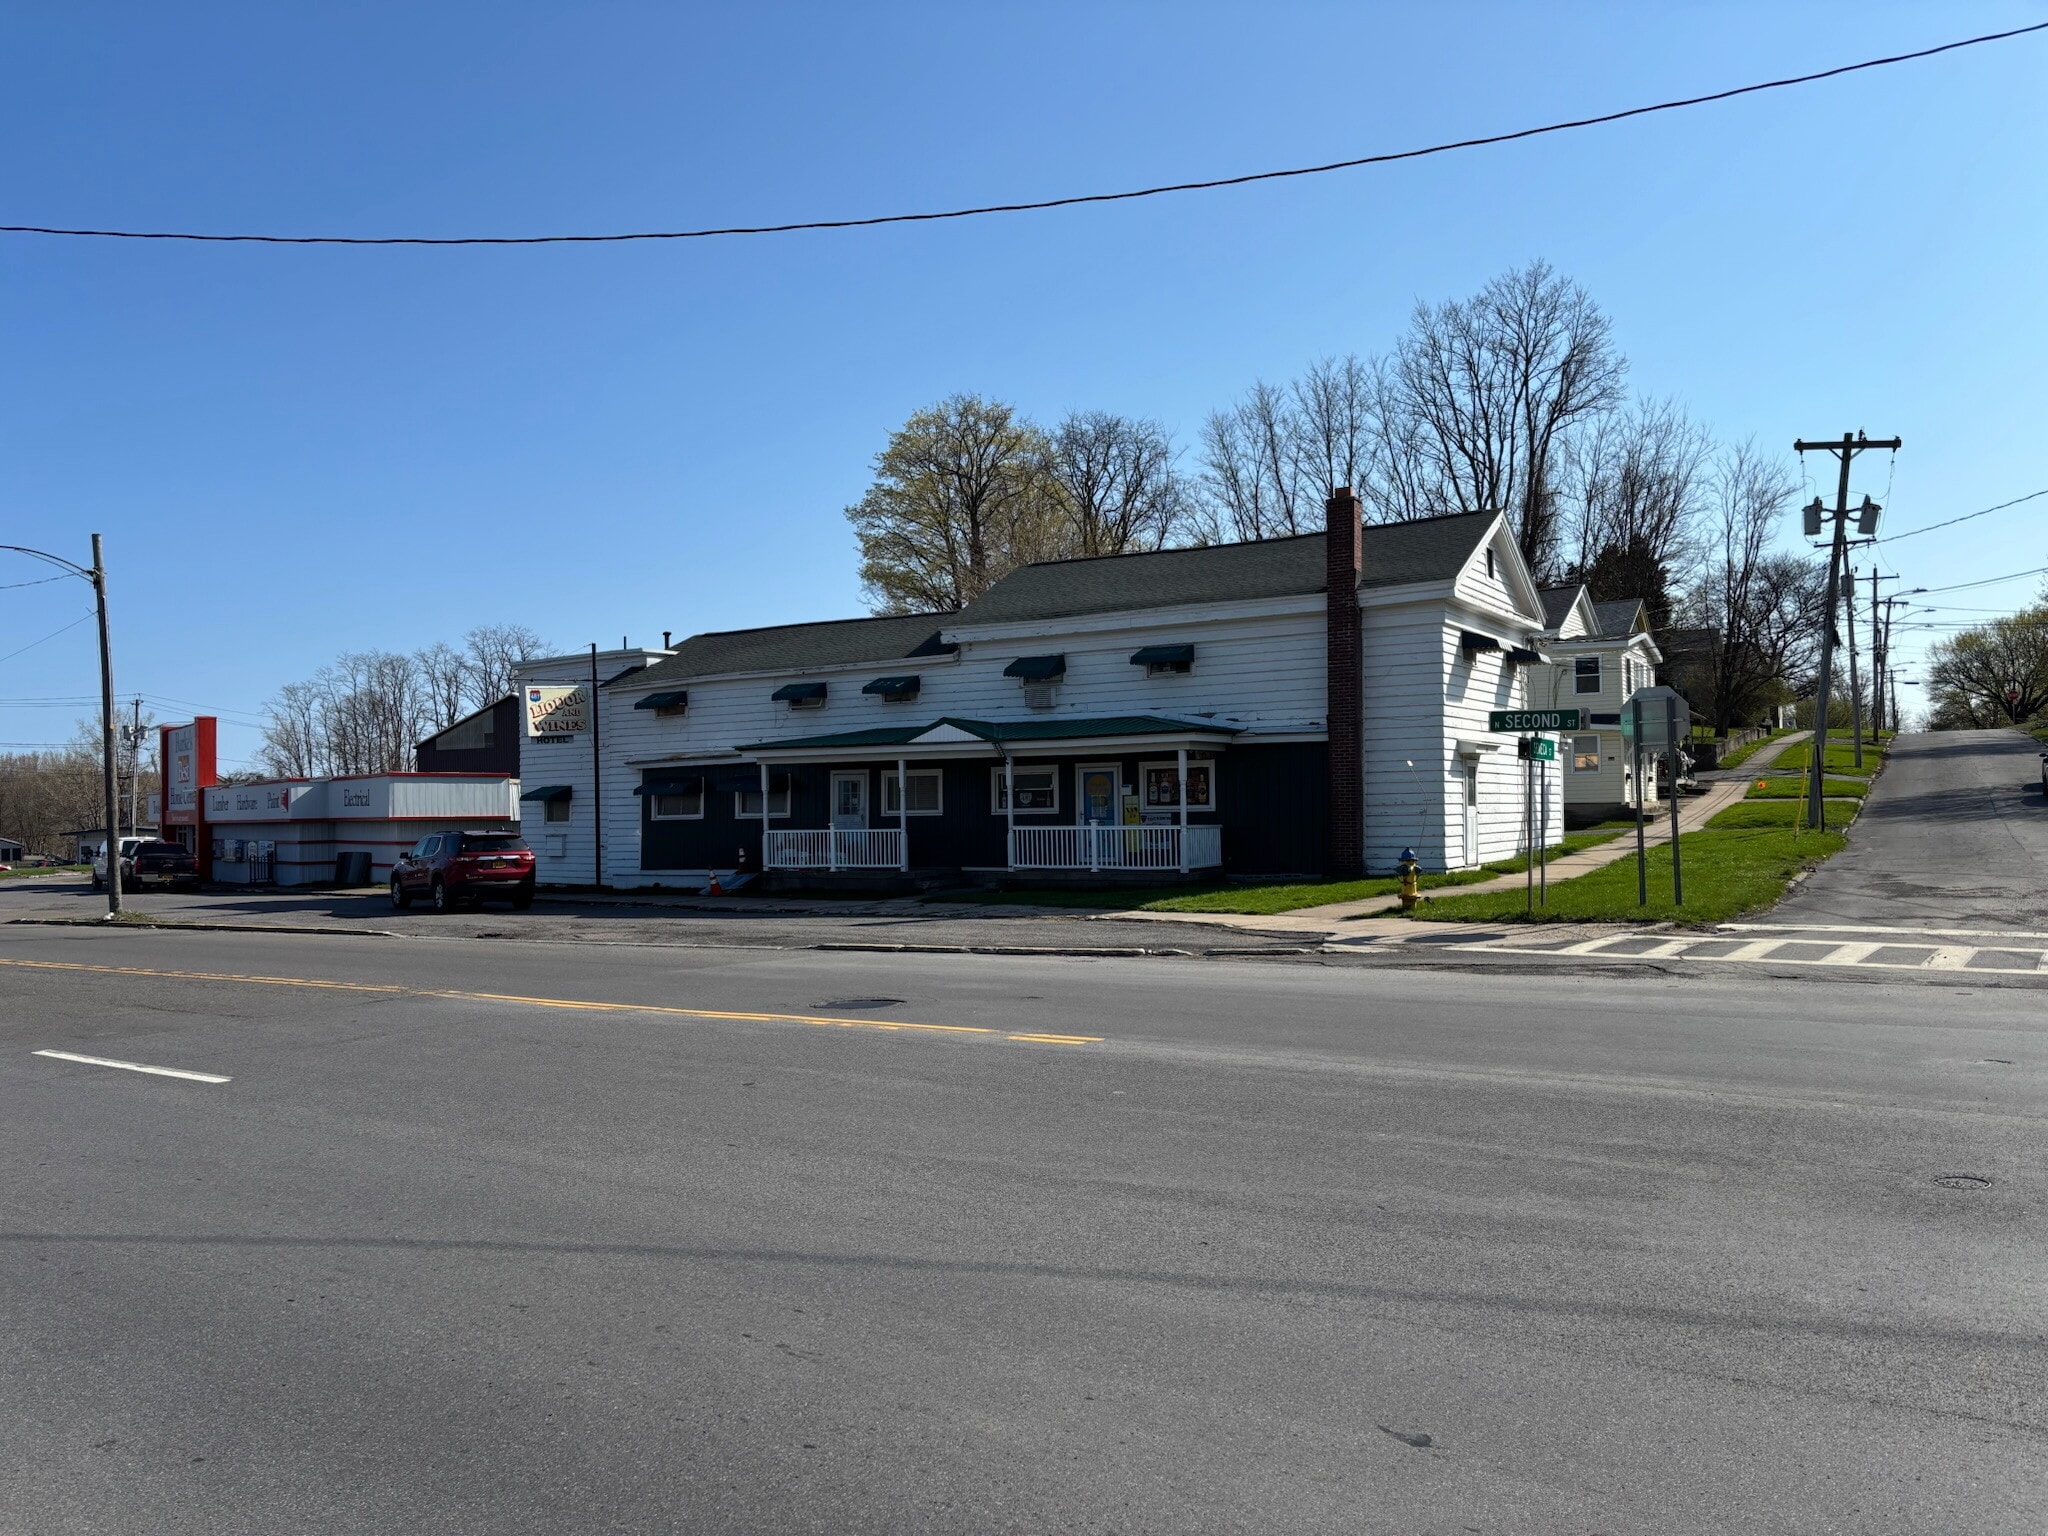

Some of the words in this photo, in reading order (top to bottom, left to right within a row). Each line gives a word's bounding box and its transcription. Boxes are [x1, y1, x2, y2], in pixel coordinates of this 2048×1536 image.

[530, 689, 586, 718] LIQUOR
[561, 708, 581, 717] AND
[533, 719, 587, 732] WINES
[1505, 713, 1560, 728] SECOND
[536, 736, 569, 744] HOTEL
[212, 795, 229, 811] Lumber
[236, 794, 258, 810] Hardware
[267, 792, 280, 809] Paint
[344, 788, 370, 806] Electrical
